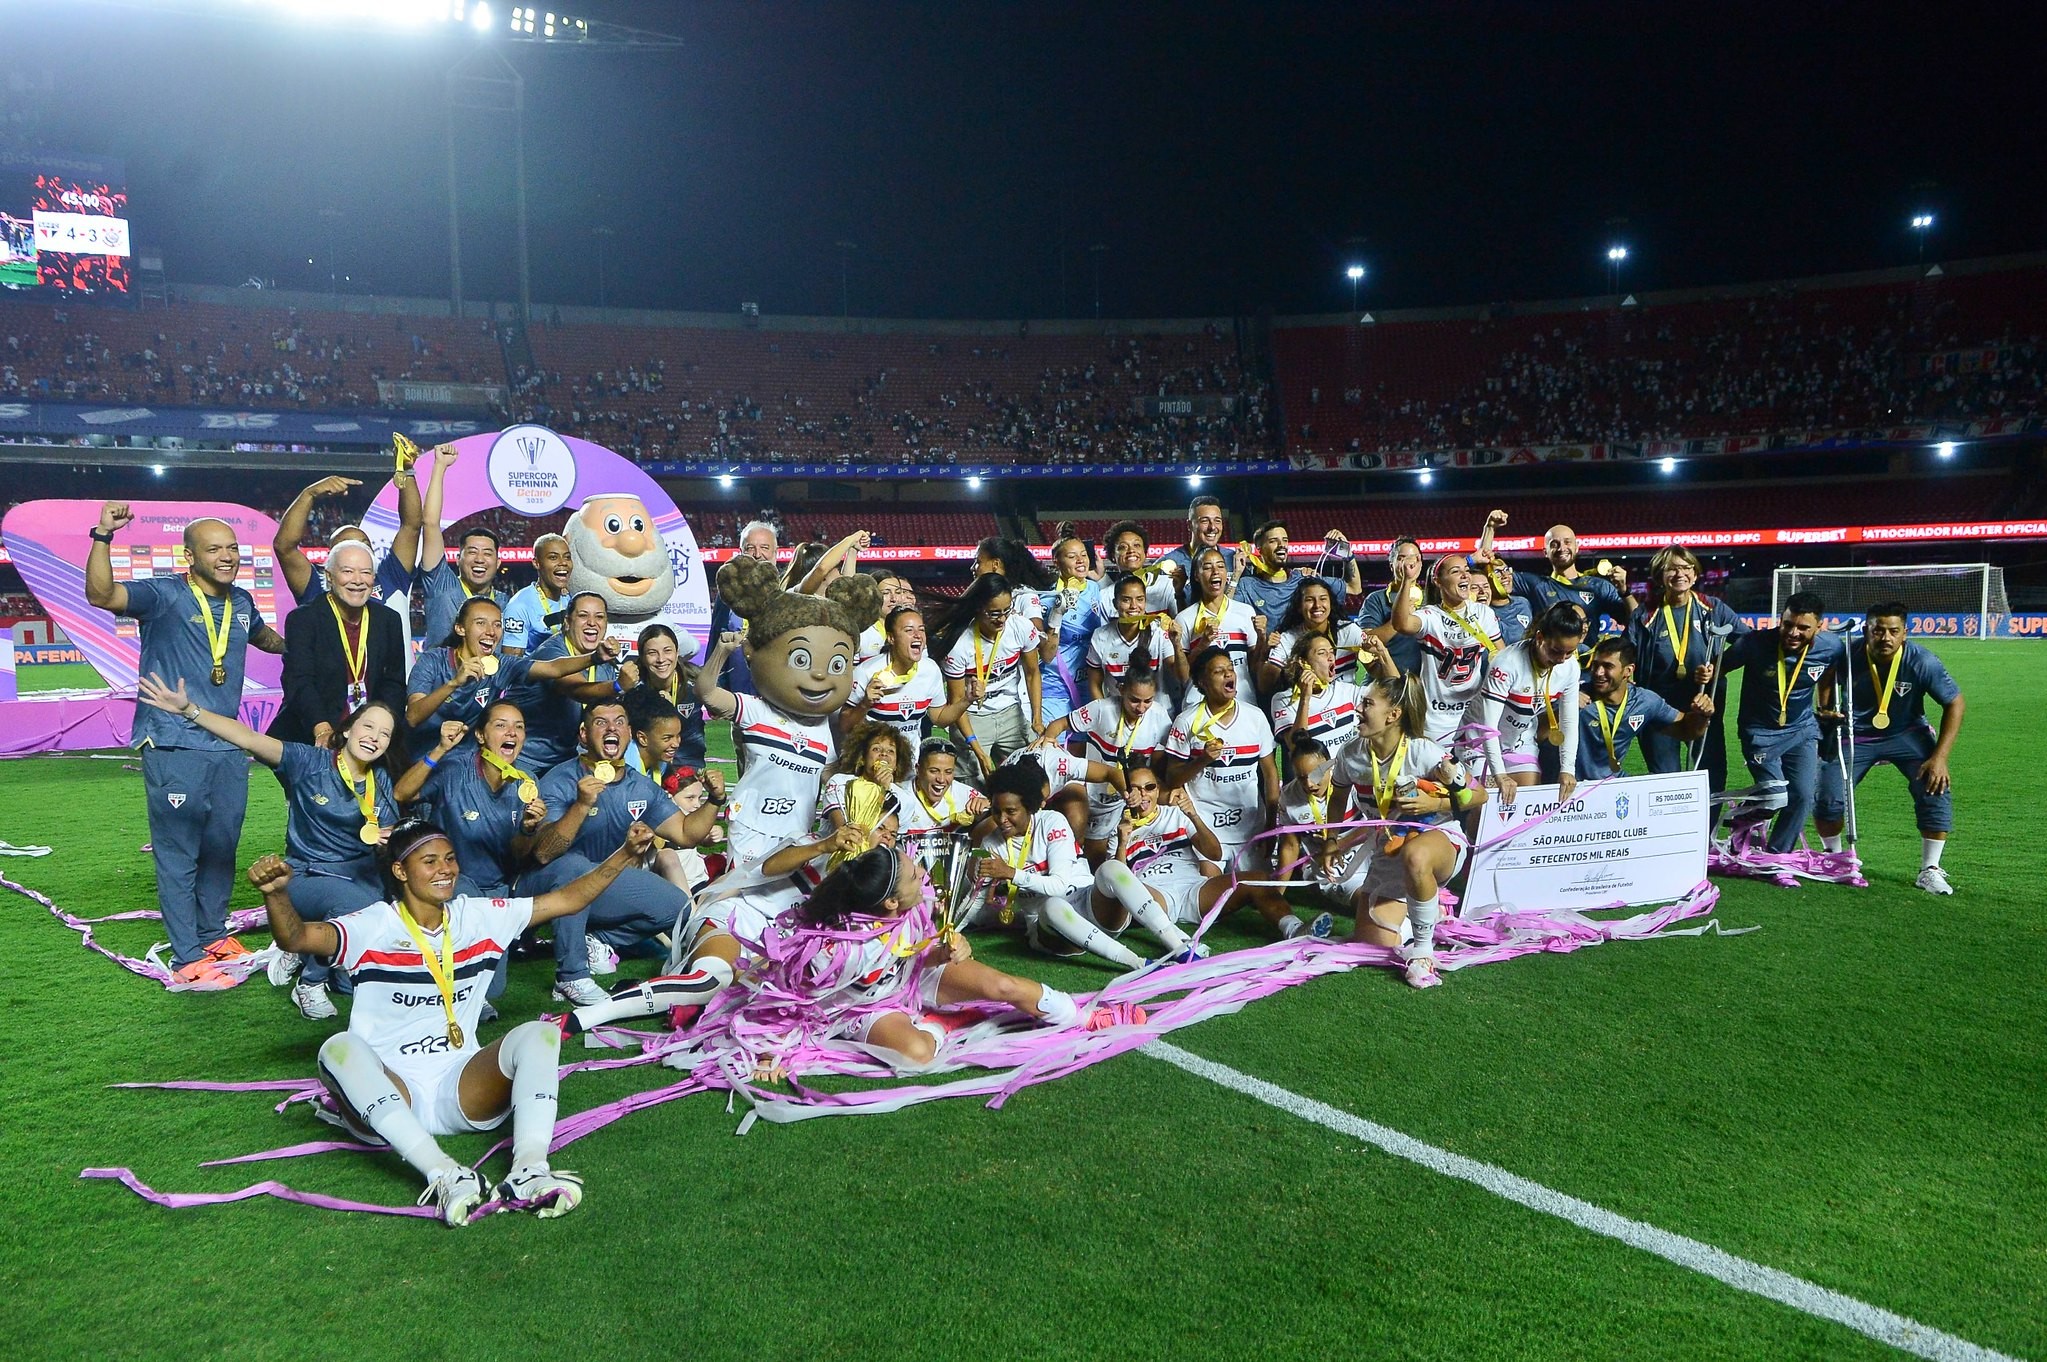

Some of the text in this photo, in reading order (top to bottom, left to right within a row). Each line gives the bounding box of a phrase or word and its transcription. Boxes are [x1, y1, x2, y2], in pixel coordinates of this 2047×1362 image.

[67, 227, 75, 240] 4
[89, 229, 97, 242] 3
[1159, 401, 1191, 413] PINTADO
[508, 472, 558, 480] SUPERCOPA
[517, 488, 552, 497] Betano
[163, 524, 185, 532] Beta
[1951, 525, 2004, 536] MASTER
[1577, 533, 1760, 547] OCINADOR MASTER OFICIAL DO SPFC
[1776, 529, 1847, 543] SUPERBET
[1351, 543, 1381, 552] ASTER
[1420, 541, 1460, 550] DO SPFC
[1475, 537, 1535, 550] SPERBET
[306, 552, 329, 561] SPF
[884, 550, 897, 558] DO
[898, 550, 921, 558] SPFC
[505, 618, 524, 630] abc
[1911, 617, 1957, 634] 2025
[768, 753, 820, 776] SUPERBET
[1204, 770, 1252, 784] SUPERBET
[1664, 792, 1693, 802] 700.000,00
[1563, 813, 1593, 823] FEMININA
[1594, 812, 1608, 820] 2025
[1649, 808, 1663, 816] Data
[1047, 828, 1067, 842] abc
[1533, 834, 1552, 846] SÃO
[1554, 833, 1583, 844] PAULO
[1585, 829, 1623, 842] FUTEBOL
[1623, 827, 1648, 838] CLUBE
[932, 838, 953, 846] COPA
[1529, 848, 1630, 865] SETECENTOS MIL REAIS
[1559, 885, 1590, 893] Confederação
[643, 991, 655, 1014] SPF
[361, 1093, 401, 1123] SPFC
